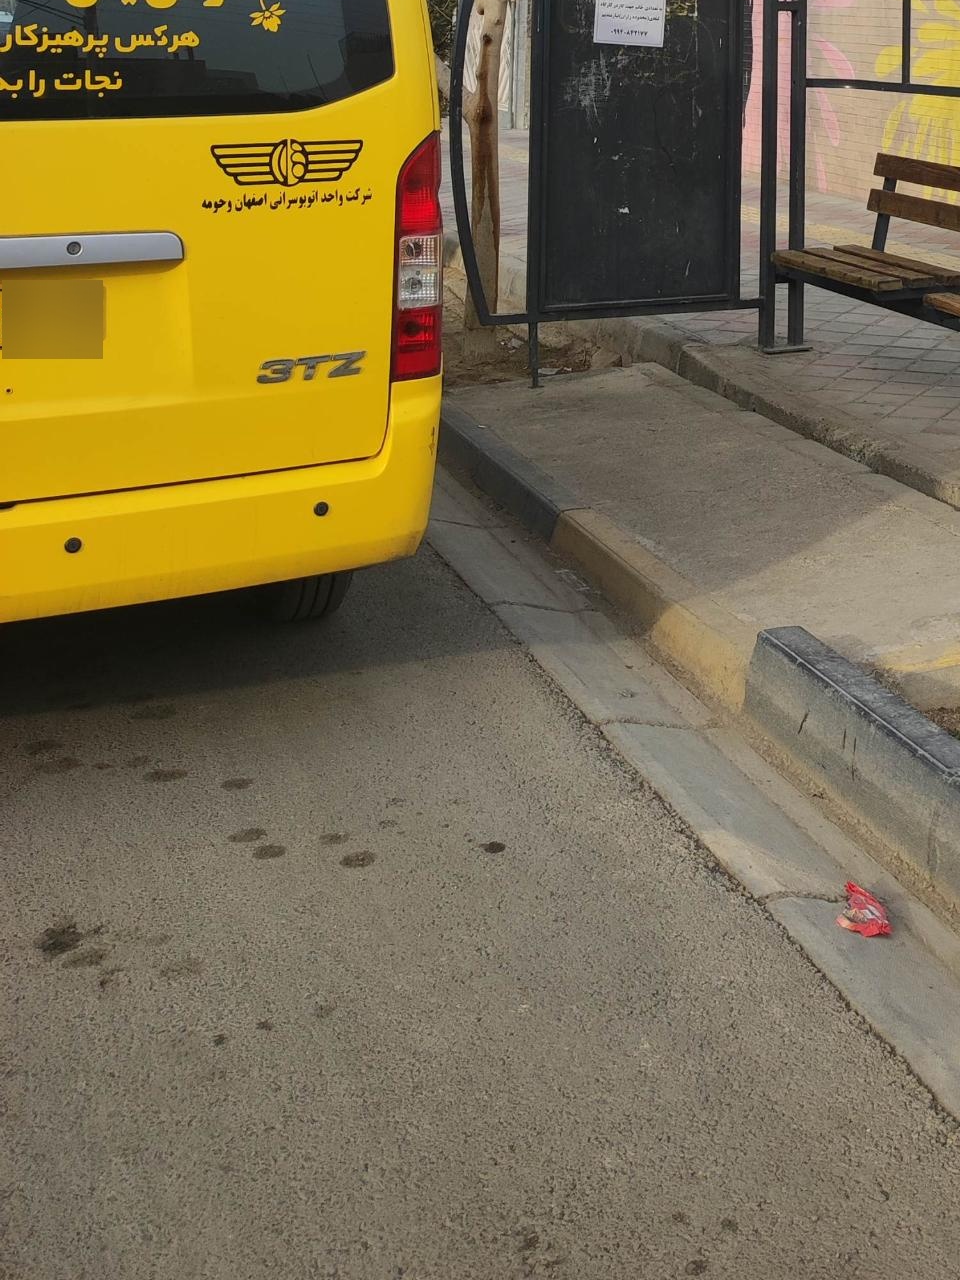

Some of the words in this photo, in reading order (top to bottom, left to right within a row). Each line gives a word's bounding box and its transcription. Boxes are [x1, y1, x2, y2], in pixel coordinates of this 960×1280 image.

[29, 70, 46, 98] را
[54, 70, 123, 98] نجات
[234, 193, 267, 212] اصفهان
[269, 190, 319, 210] اتوبوسرانی
[321, 189, 343, 206] واحد
[345, 187, 373, 205] شرکت
[256, 350, 367, 384] 3TZ
